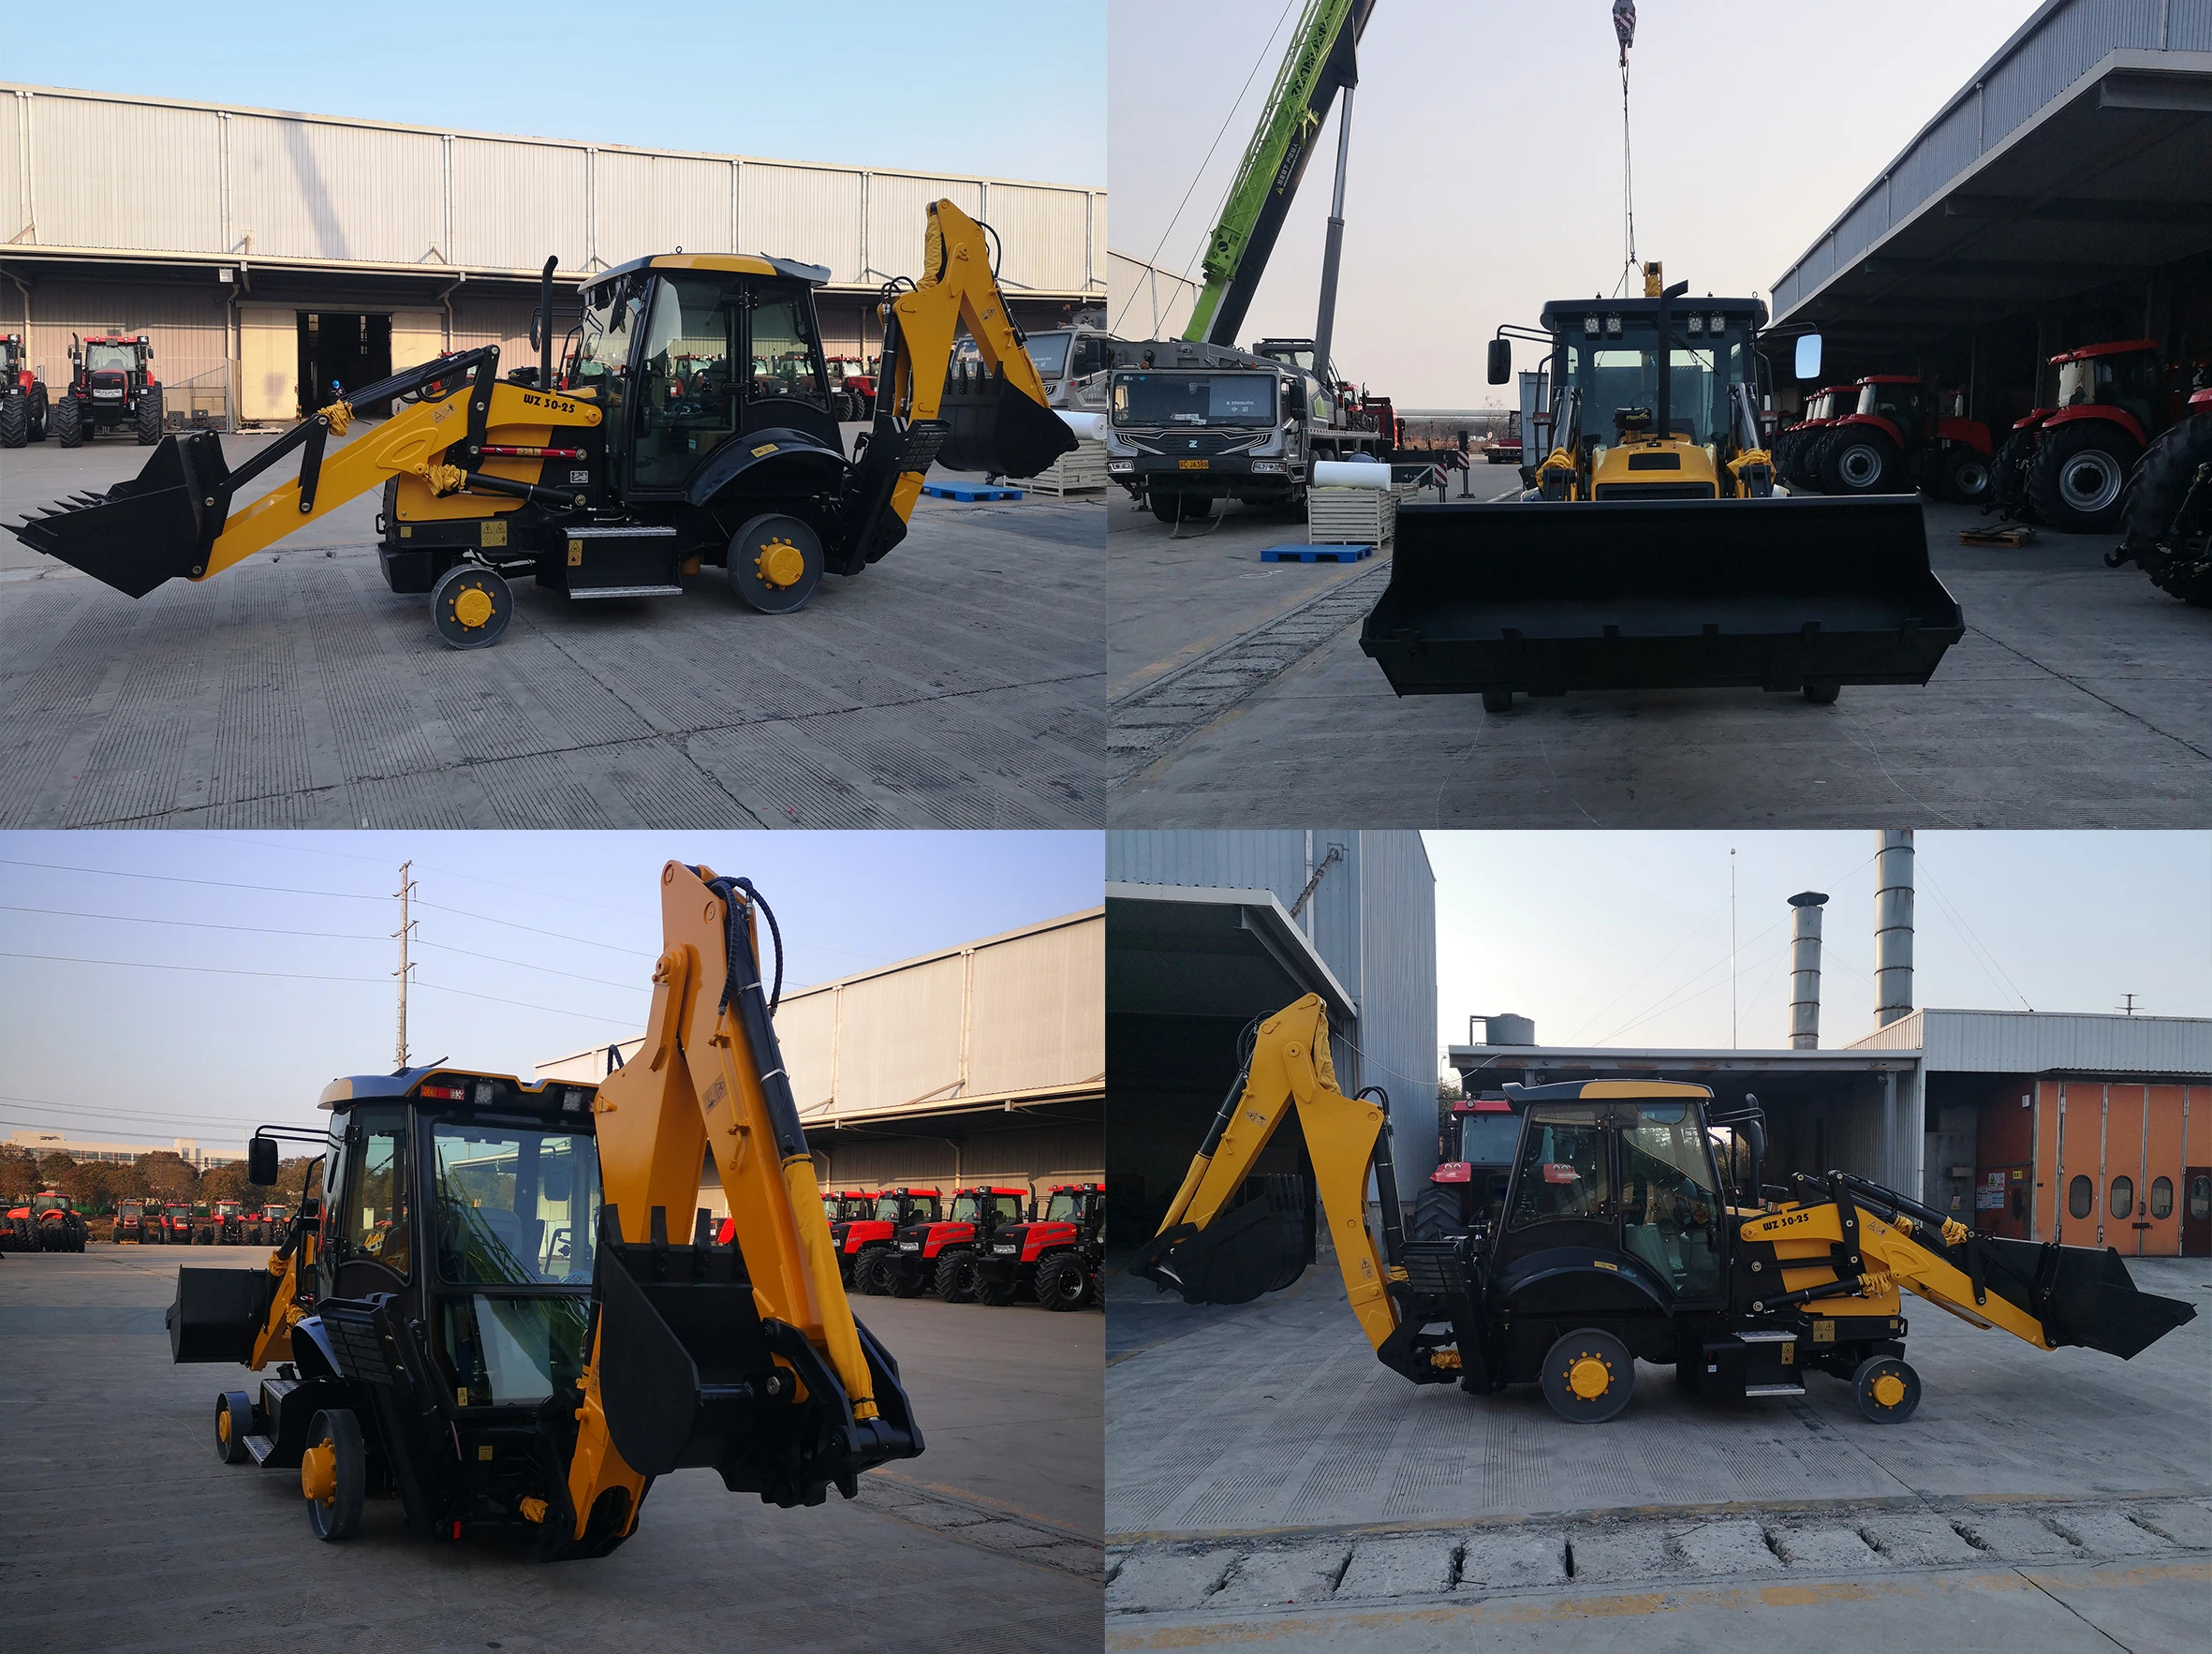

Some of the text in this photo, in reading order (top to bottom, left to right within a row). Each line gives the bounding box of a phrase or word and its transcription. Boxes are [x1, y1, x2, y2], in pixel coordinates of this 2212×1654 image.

[524, 393, 575, 413] WZ 30-25
[1762, 1213, 1809, 1232] WZ 30-25
